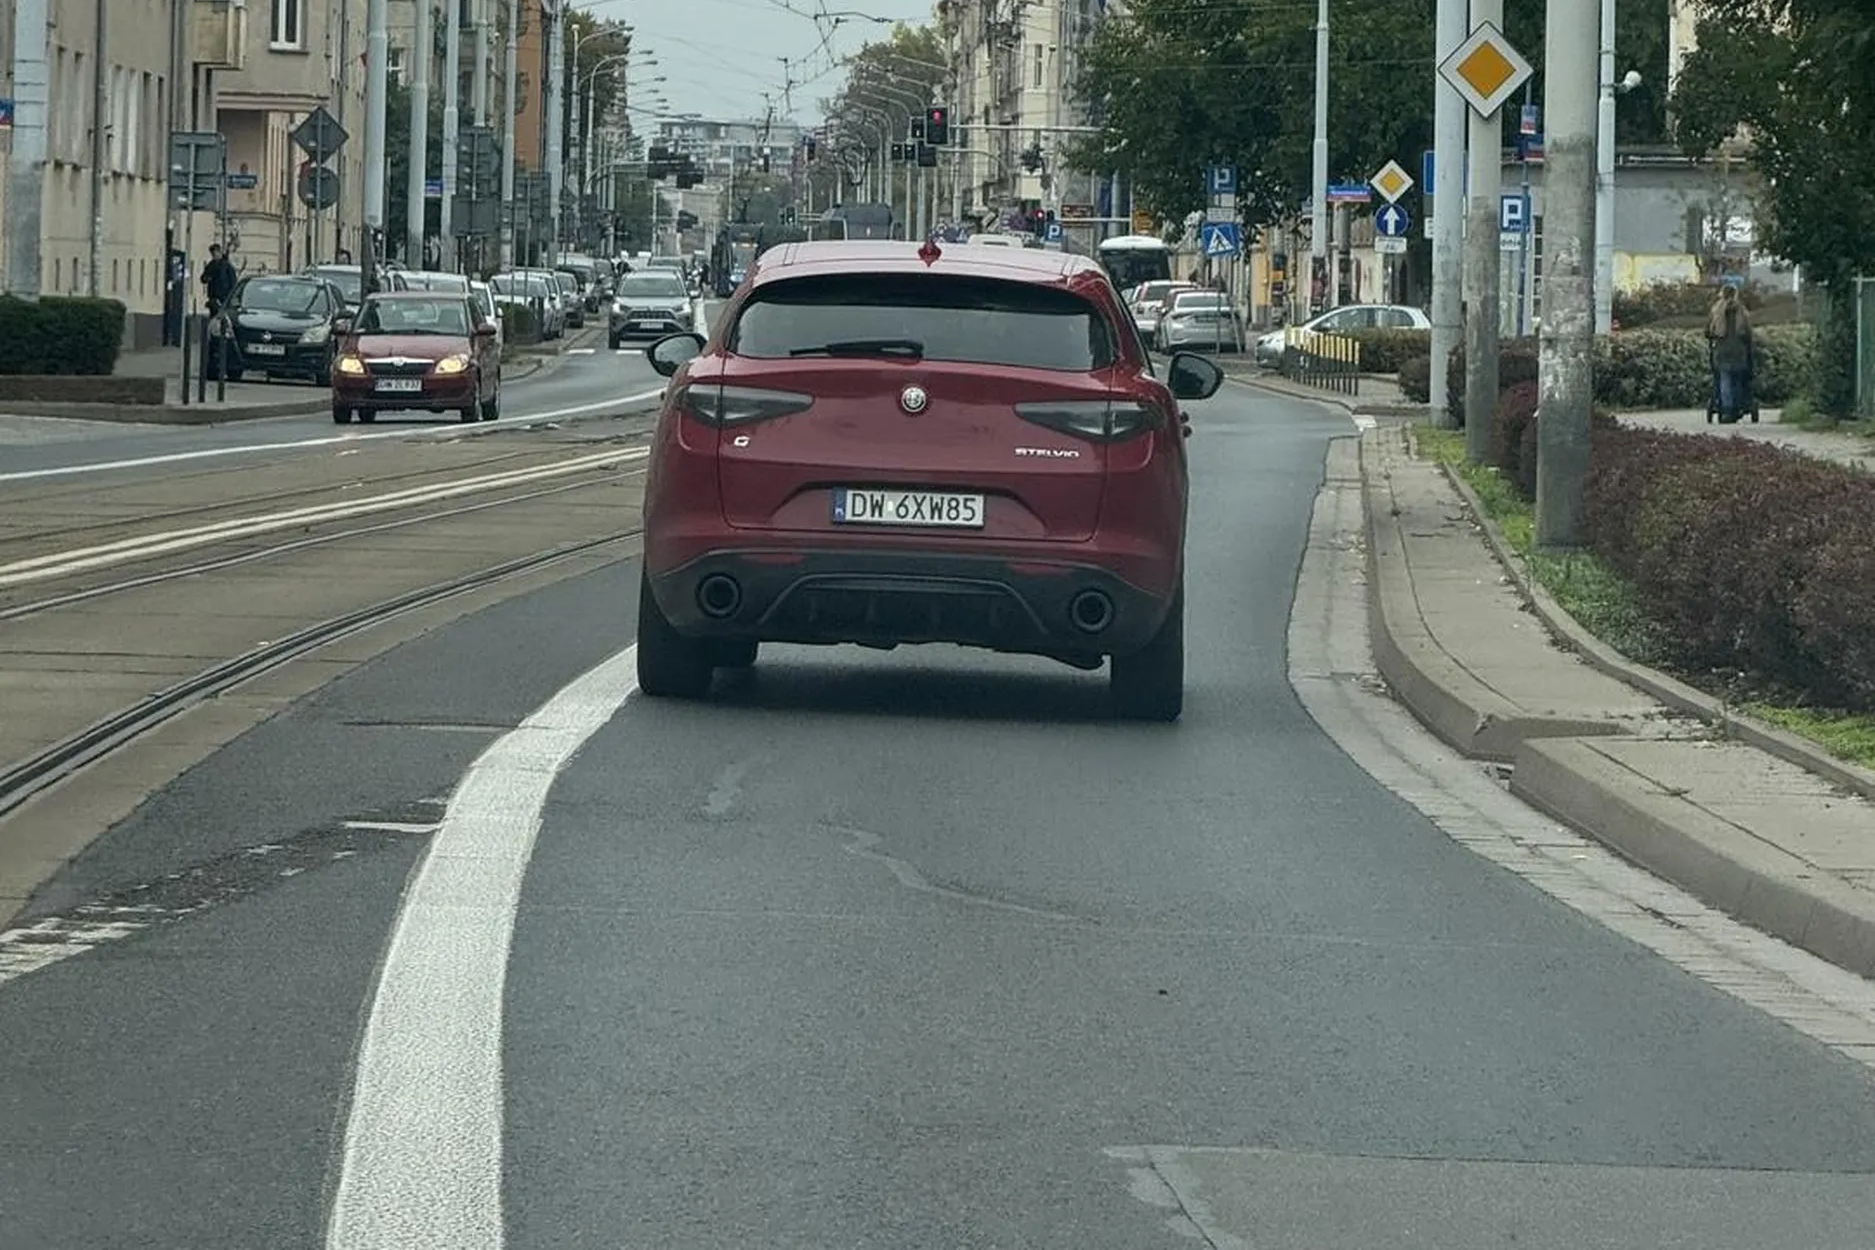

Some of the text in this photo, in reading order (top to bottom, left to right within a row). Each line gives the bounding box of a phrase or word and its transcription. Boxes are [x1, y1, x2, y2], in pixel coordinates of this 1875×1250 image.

[1213, 167, 1231, 190] P
[1502, 198, 1523, 228] P
[1048, 224, 1061, 239] P
[1014, 447, 1080, 458] STELVIO
[851, 492, 976, 522] DW 6XW85
